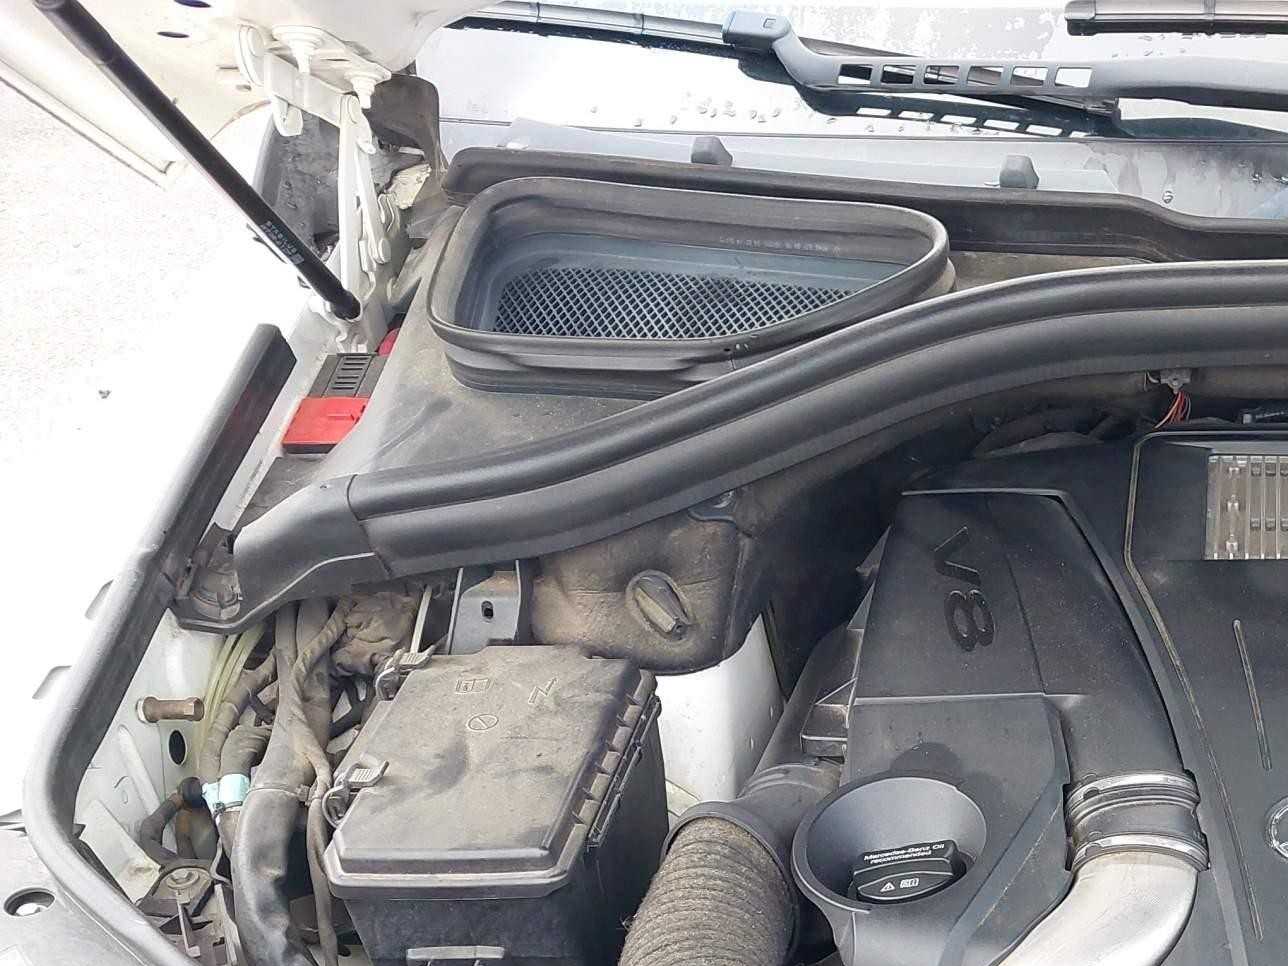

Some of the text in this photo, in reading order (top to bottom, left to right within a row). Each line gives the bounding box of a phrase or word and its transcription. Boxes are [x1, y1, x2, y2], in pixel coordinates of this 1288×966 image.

[933, 525, 995, 653] V8
[863, 846, 931, 861] Mercedes-Benz
[870, 850, 932, 865] recommended
